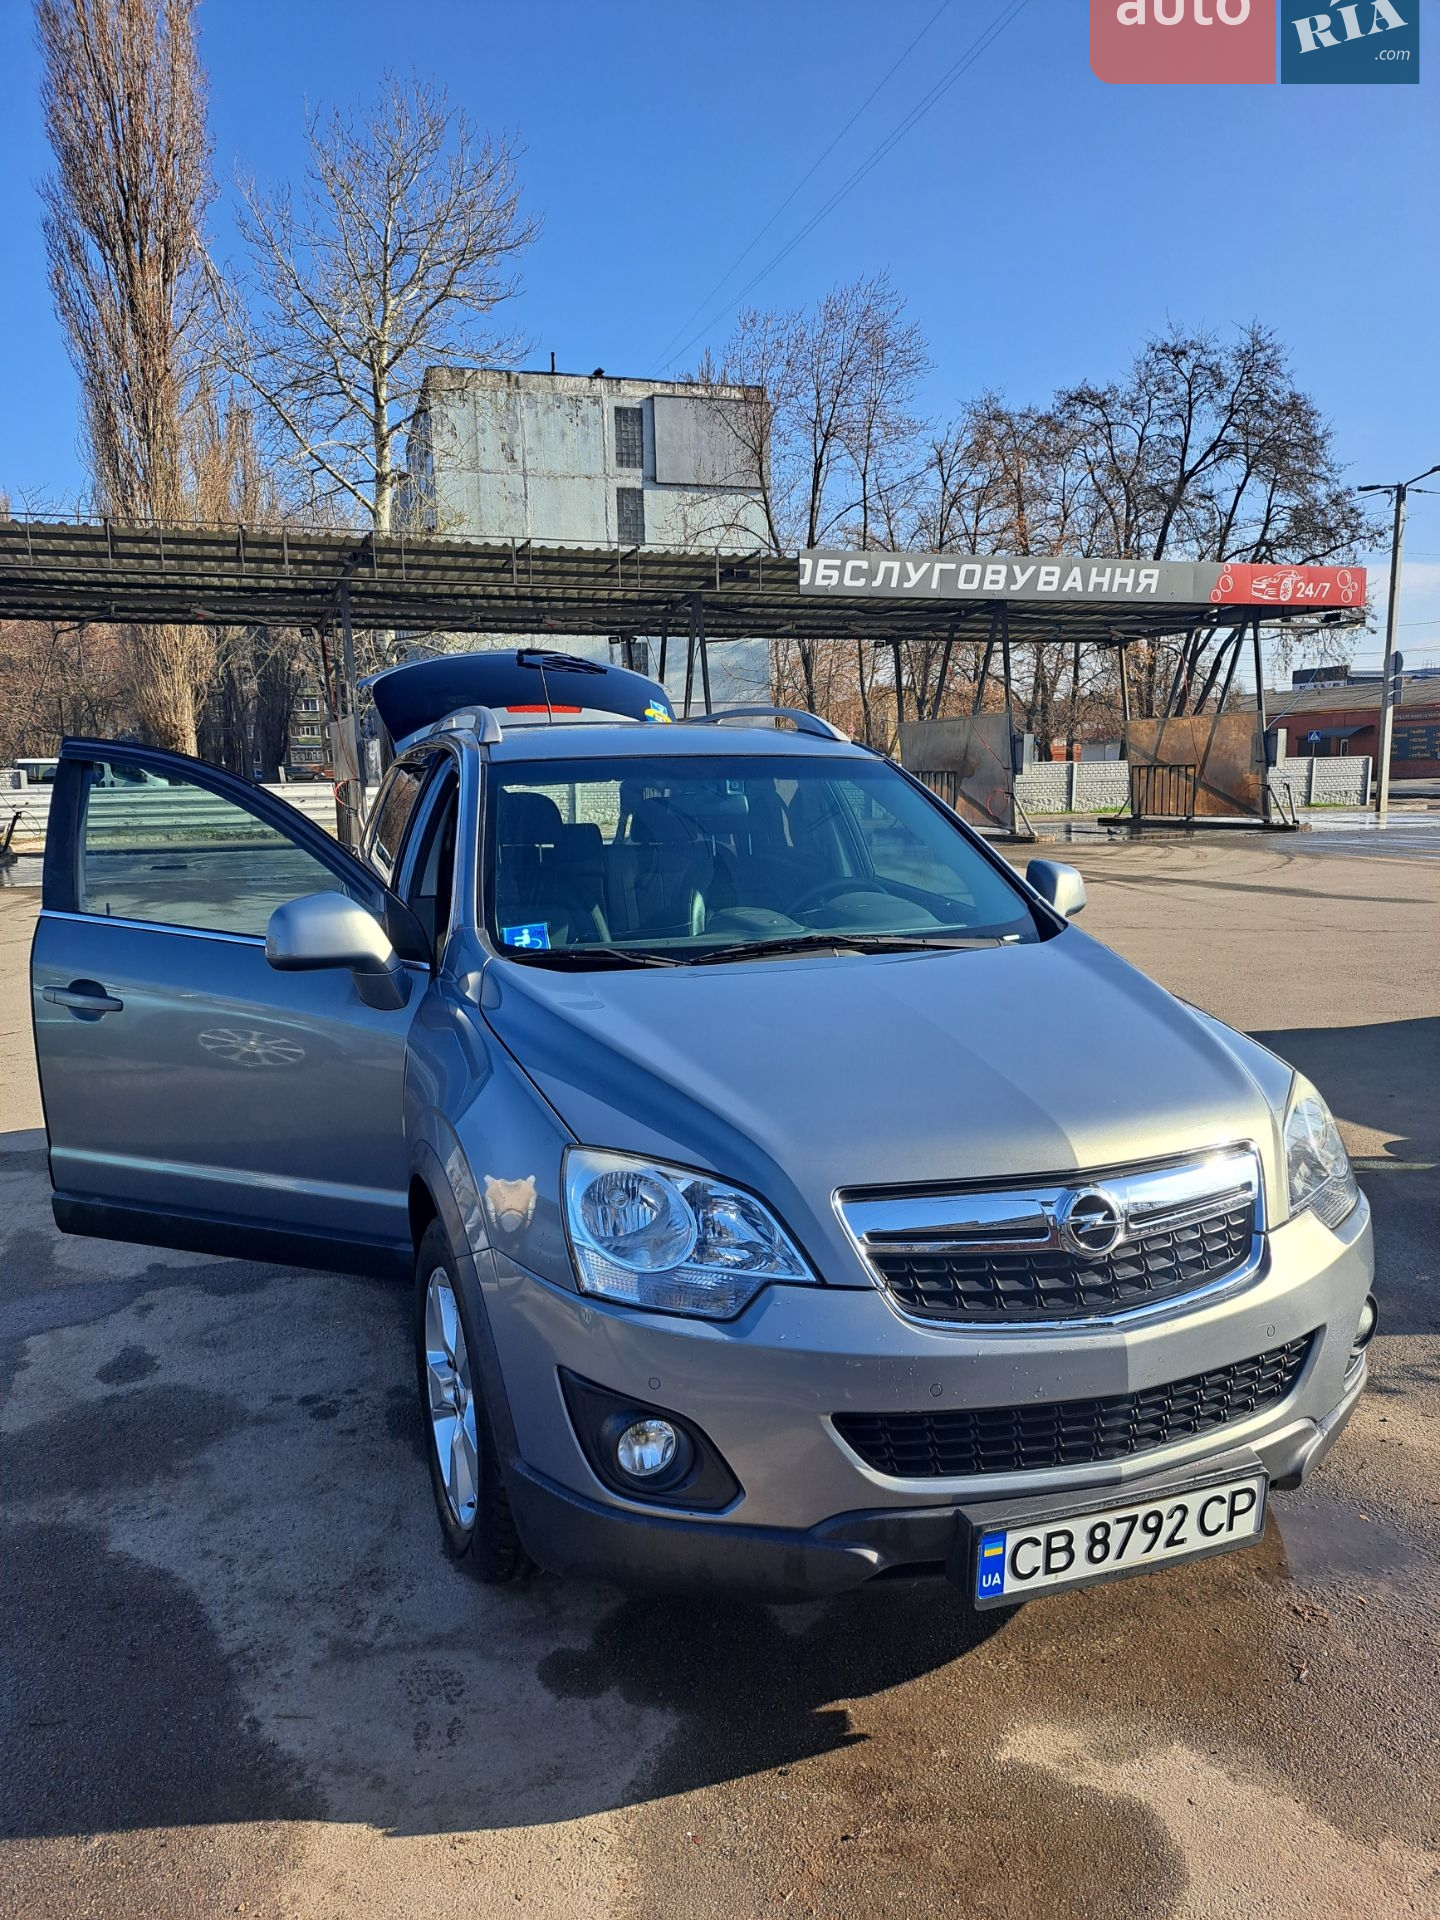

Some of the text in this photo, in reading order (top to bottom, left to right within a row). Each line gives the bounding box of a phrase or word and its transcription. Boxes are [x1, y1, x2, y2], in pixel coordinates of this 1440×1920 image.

[1296, 581, 1331, 599] 24/7
[1009, 1487, 1257, 1580] CB 8792 CP
[982, 1572, 1001, 1588] UA
